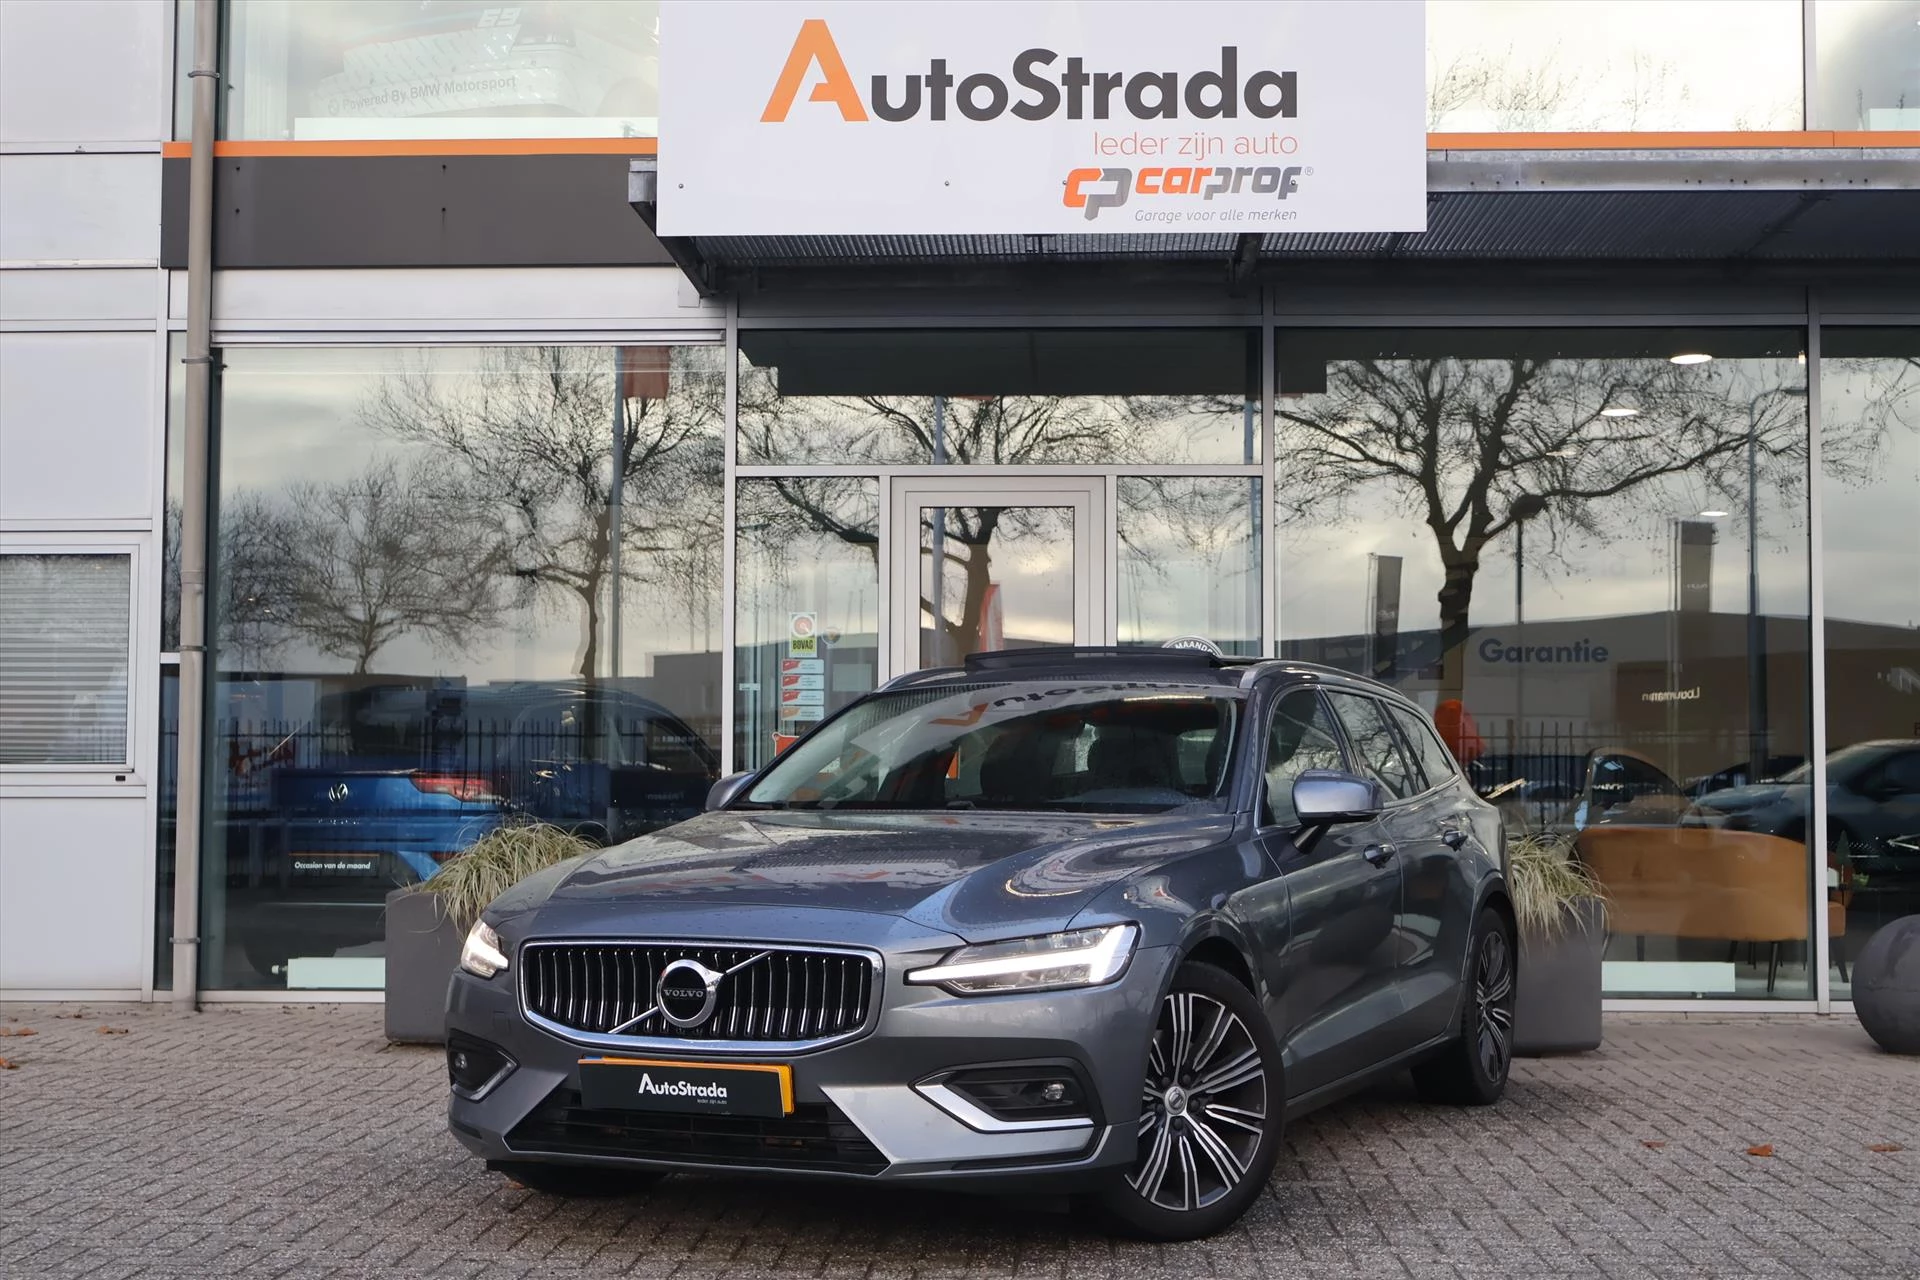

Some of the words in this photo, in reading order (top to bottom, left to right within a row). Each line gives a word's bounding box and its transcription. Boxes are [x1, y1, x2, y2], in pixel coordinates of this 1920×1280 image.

[760, 18, 1298, 123] AutoStrada
[391, 89, 407, 104] By
[410, 81, 441, 99] BMW
[444, 75, 517, 96] Motorsport
[1094, 131, 1169, 156] Ieder
[1178, 132, 1224, 161] zijn
[1234, 132, 1298, 155] auto
[1135, 209, 1182, 224] Garage
[1187, 211, 1216, 221] voor
[1220, 208, 1244, 221] alle
[1248, 208, 1297, 221] merken
[792, 639, 814, 650] BOVAG
[1478, 638, 1609, 663] Garantie
[294, 861, 323, 870] Occasion
[337, 861, 346, 869] de
[346, 861, 371, 870] maand
[663, 988, 704, 998] VOLVO
[638, 1072, 728, 1098] AutoStrada
